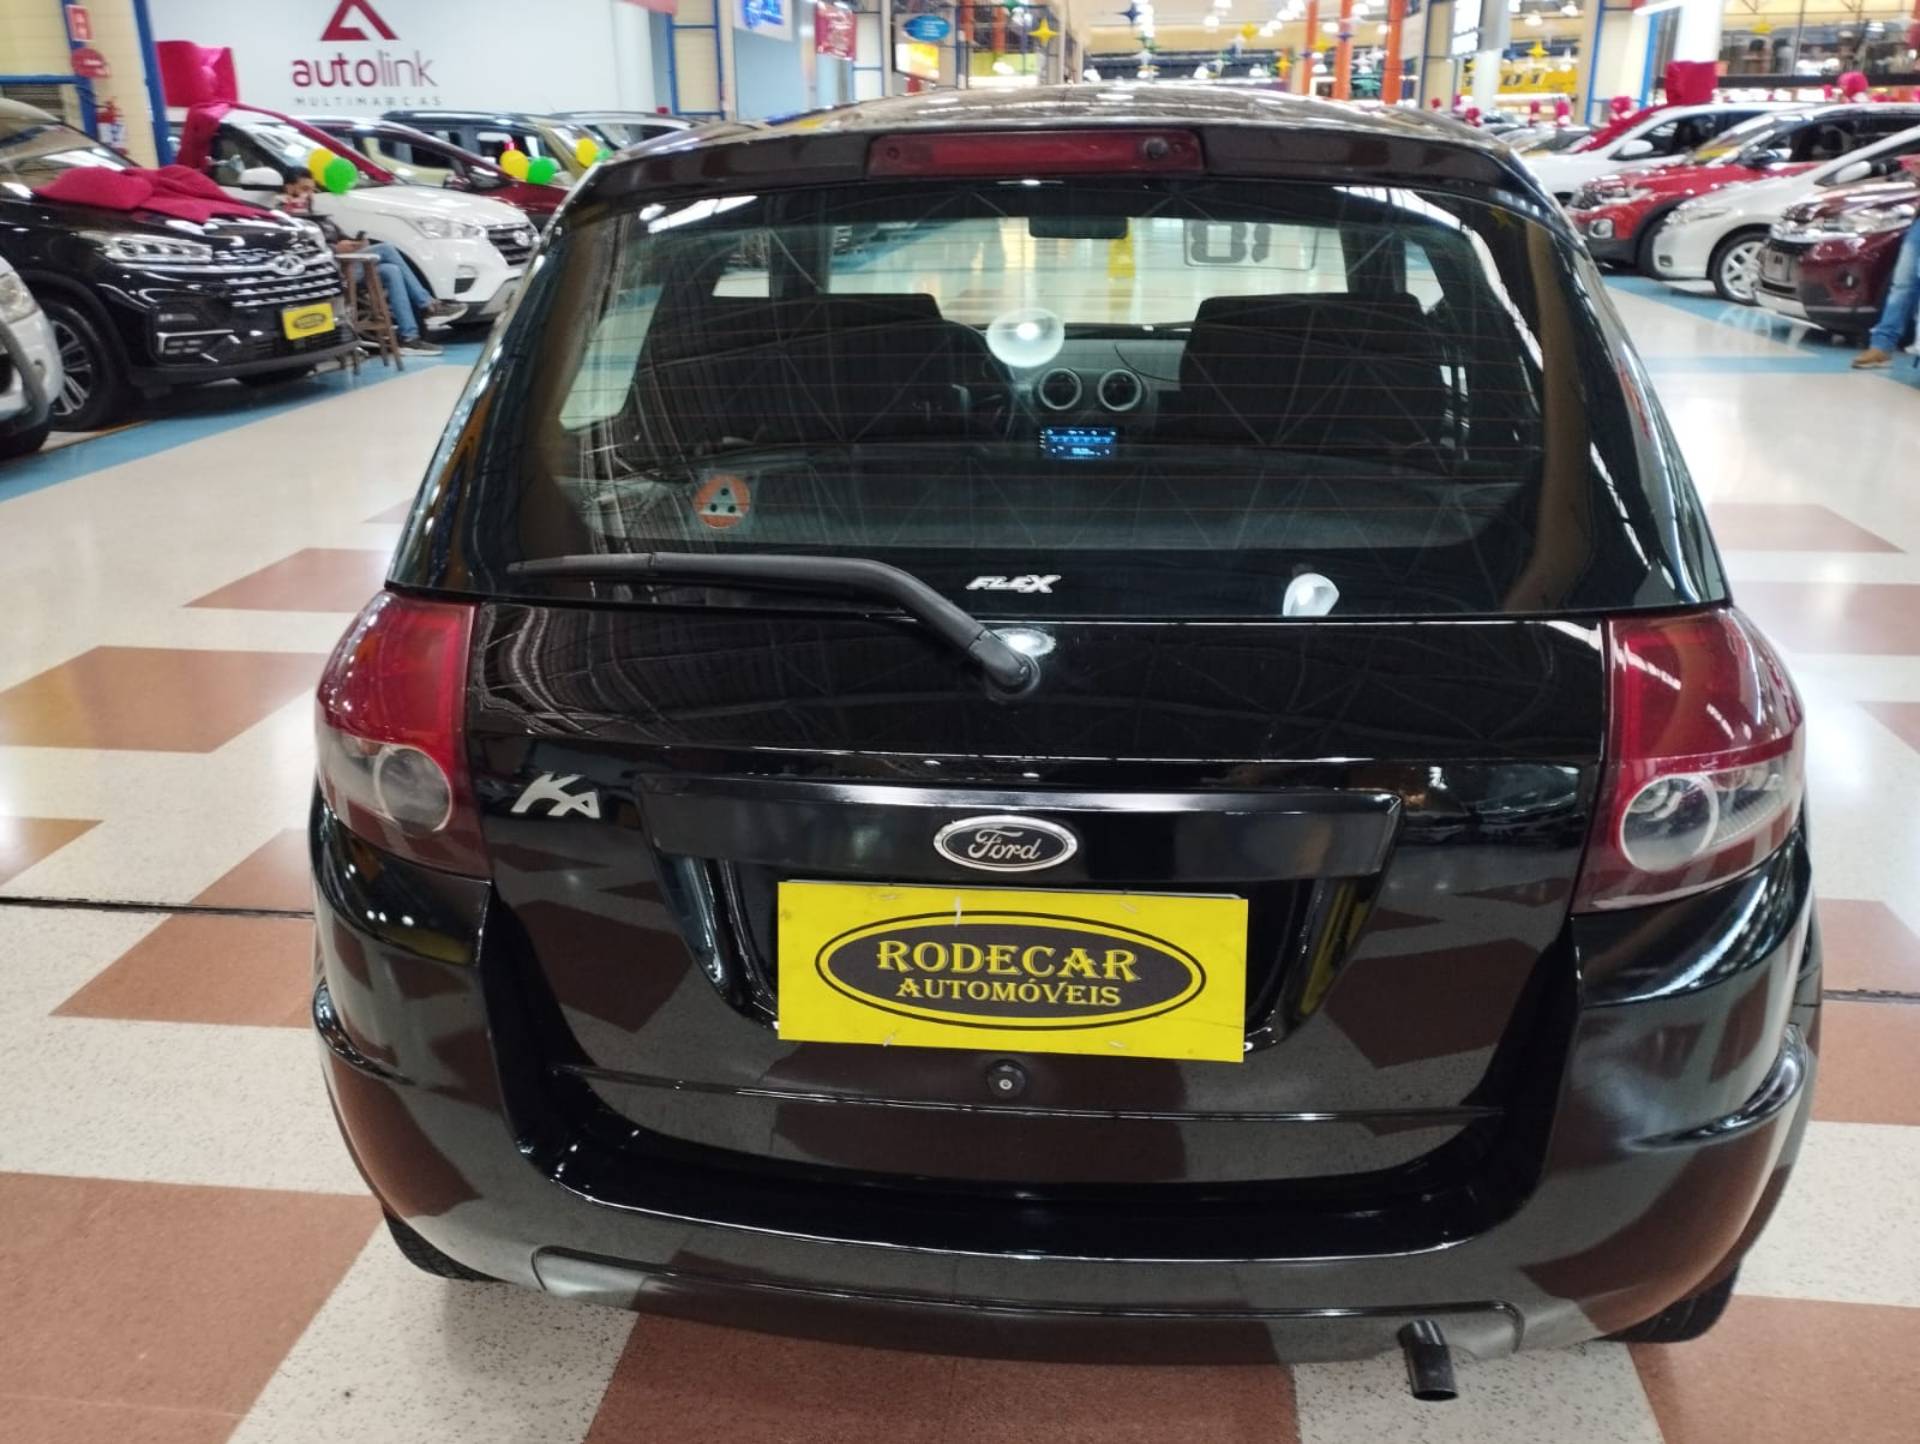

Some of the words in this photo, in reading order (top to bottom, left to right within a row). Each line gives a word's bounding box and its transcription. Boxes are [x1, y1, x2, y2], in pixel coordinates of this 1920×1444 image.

[291, 49, 439, 87] autolink
[294, 97, 442, 107] MULTIMARCAS
[966, 574, 1061, 595] FLEX
[965, 829, 1043, 862] Ford
[876, 940, 1141, 982] RODECAR
[895, 977, 1122, 1007] AUTOMÓVEIS
